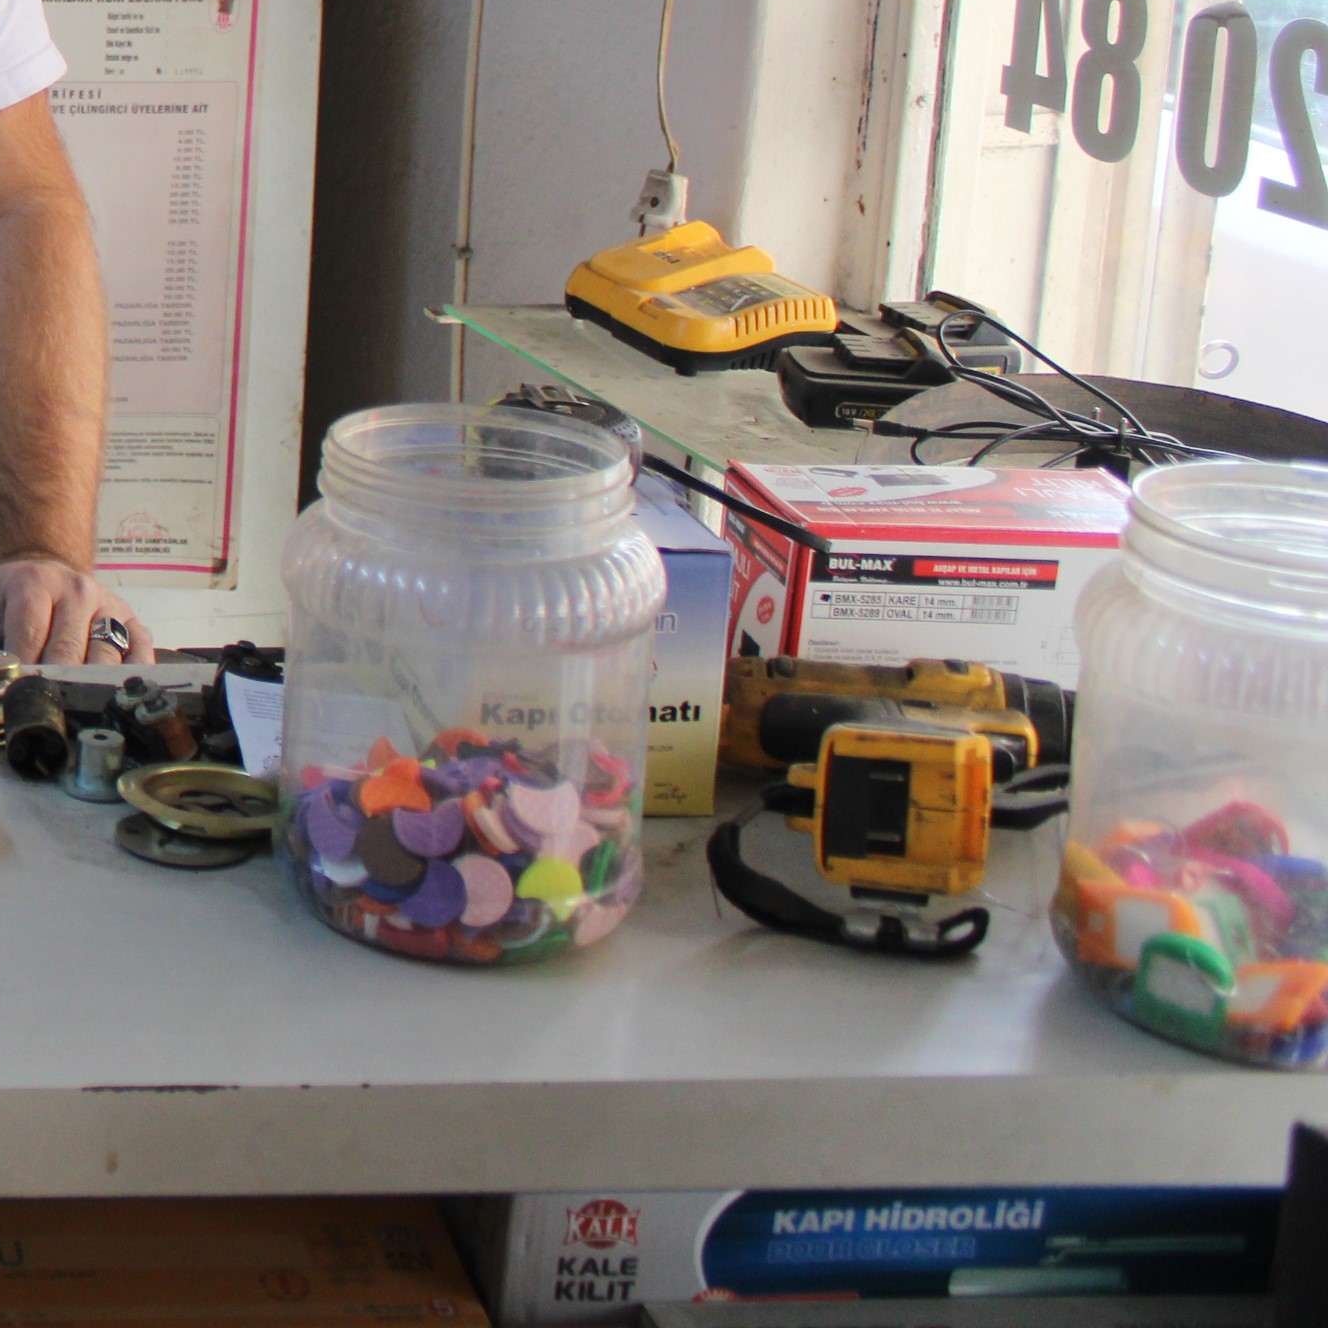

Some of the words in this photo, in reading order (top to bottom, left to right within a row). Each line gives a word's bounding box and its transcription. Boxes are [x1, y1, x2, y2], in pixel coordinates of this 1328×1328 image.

[829, 557, 893, 571] BUL-MAX
[834, 594, 882, 605] BMX-5285
[888, 595, 917, 606] KARE
[886, 609, 913, 619] OVAL
[772, 1207, 855, 1235] KAPI
[864, 1200, 1046, 1233] HİDROLİĞİ
[563, 1209, 641, 1245] KALE
[556, 1256, 639, 1277] KALE
